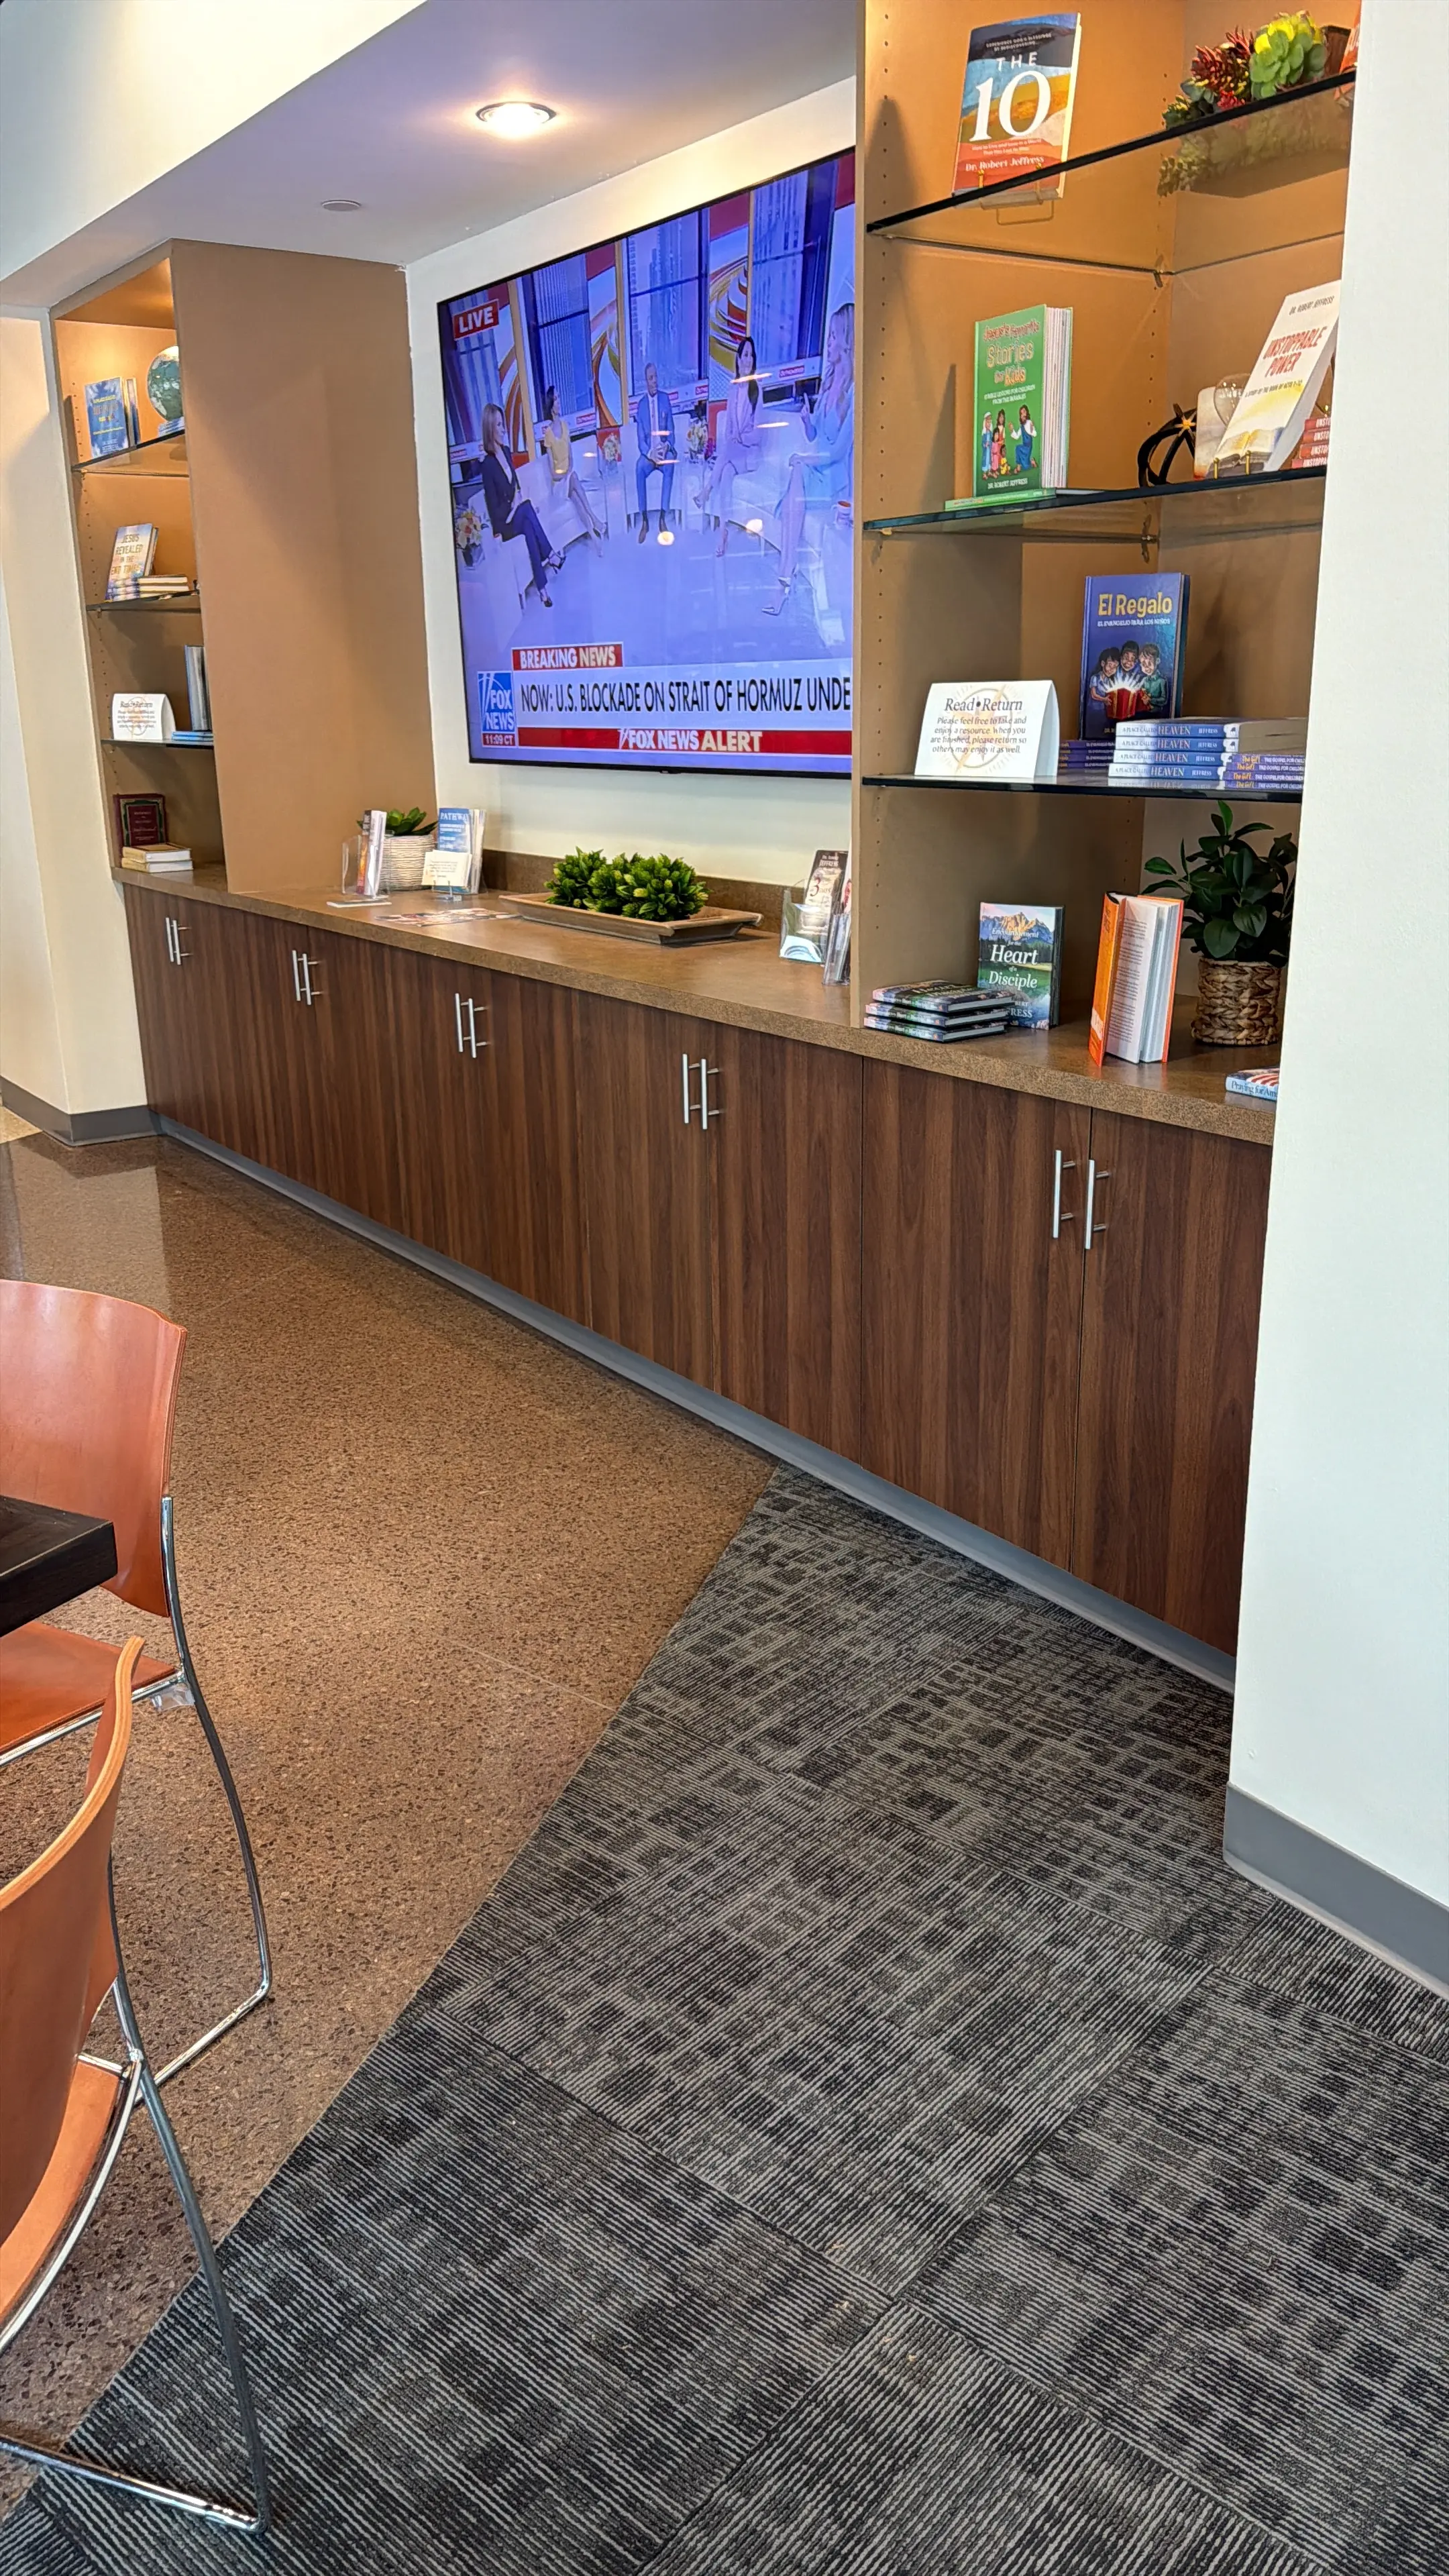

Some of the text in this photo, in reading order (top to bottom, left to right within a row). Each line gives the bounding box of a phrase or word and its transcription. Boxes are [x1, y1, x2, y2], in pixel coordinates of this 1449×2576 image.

[996, 51, 1038, 72] THE
[969, 70, 1051, 142] 10
[965, 156, 1045, 172] Dr. Robert Jeffress
[1297, 301, 1314, 313] ROBERT
[1313, 295, 1335, 309] JEFFRESS
[459, 306, 494, 333] LIVE
[1263, 326, 1328, 360] UNSTOPPABLE
[986, 338, 1034, 368] Stories
[1265, 352, 1302, 378] POWER
[1004, 364, 1026, 386] Kids
[1010, 478, 1028, 486] JEFFRESS
[121, 534, 140, 543] JESUS
[115, 544, 144, 555] REVEALED
[1098, 591, 1173, 618] El Regalo
[520, 646, 616, 669] BREAKING NEWS
[491, 689, 512, 710] FOX
[521, 676, 851, 712] NOW: U.S. BLOCKADE ON STRAIT OF HORMUZ UNDE
[486, 712, 515, 731] NEWS
[937, 716, 959, 724] Please
[960, 716, 975, 724] feel
[975, 716, 989, 724] free
[998, 716, 1012, 724] take
[1013, 716, 1027, 724] and
[934, 727, 951, 737] enjoy
[993, 727, 1012, 735] When
[1012, 728, 1026, 736] you
[1158, 725, 1191, 735] HEAVEN
[485, 734, 514, 745] 11:09 CT
[628, 729, 763, 752] FOX NEWS ALERT
[972, 736, 994, 745] please
[1157, 739, 1190, 749] HEAVEN
[932, 745, 953, 753] others
[955, 747, 970, 755] may
[971, 745, 989, 755] enjoy
[990, 745, 996, 753] it
[1155, 753, 1188, 763] HEAVEN
[1150, 767, 1184, 776] HEAVEN
[810, 877, 821, 897] 3
[991, 927, 1039, 938] Encouragement
[989, 944, 1038, 965] Heart
[988, 971, 1038, 991] Disciple
[1232, 1080, 1254, 1094] Praying
[1254, 1085, 1264, 1094] for
